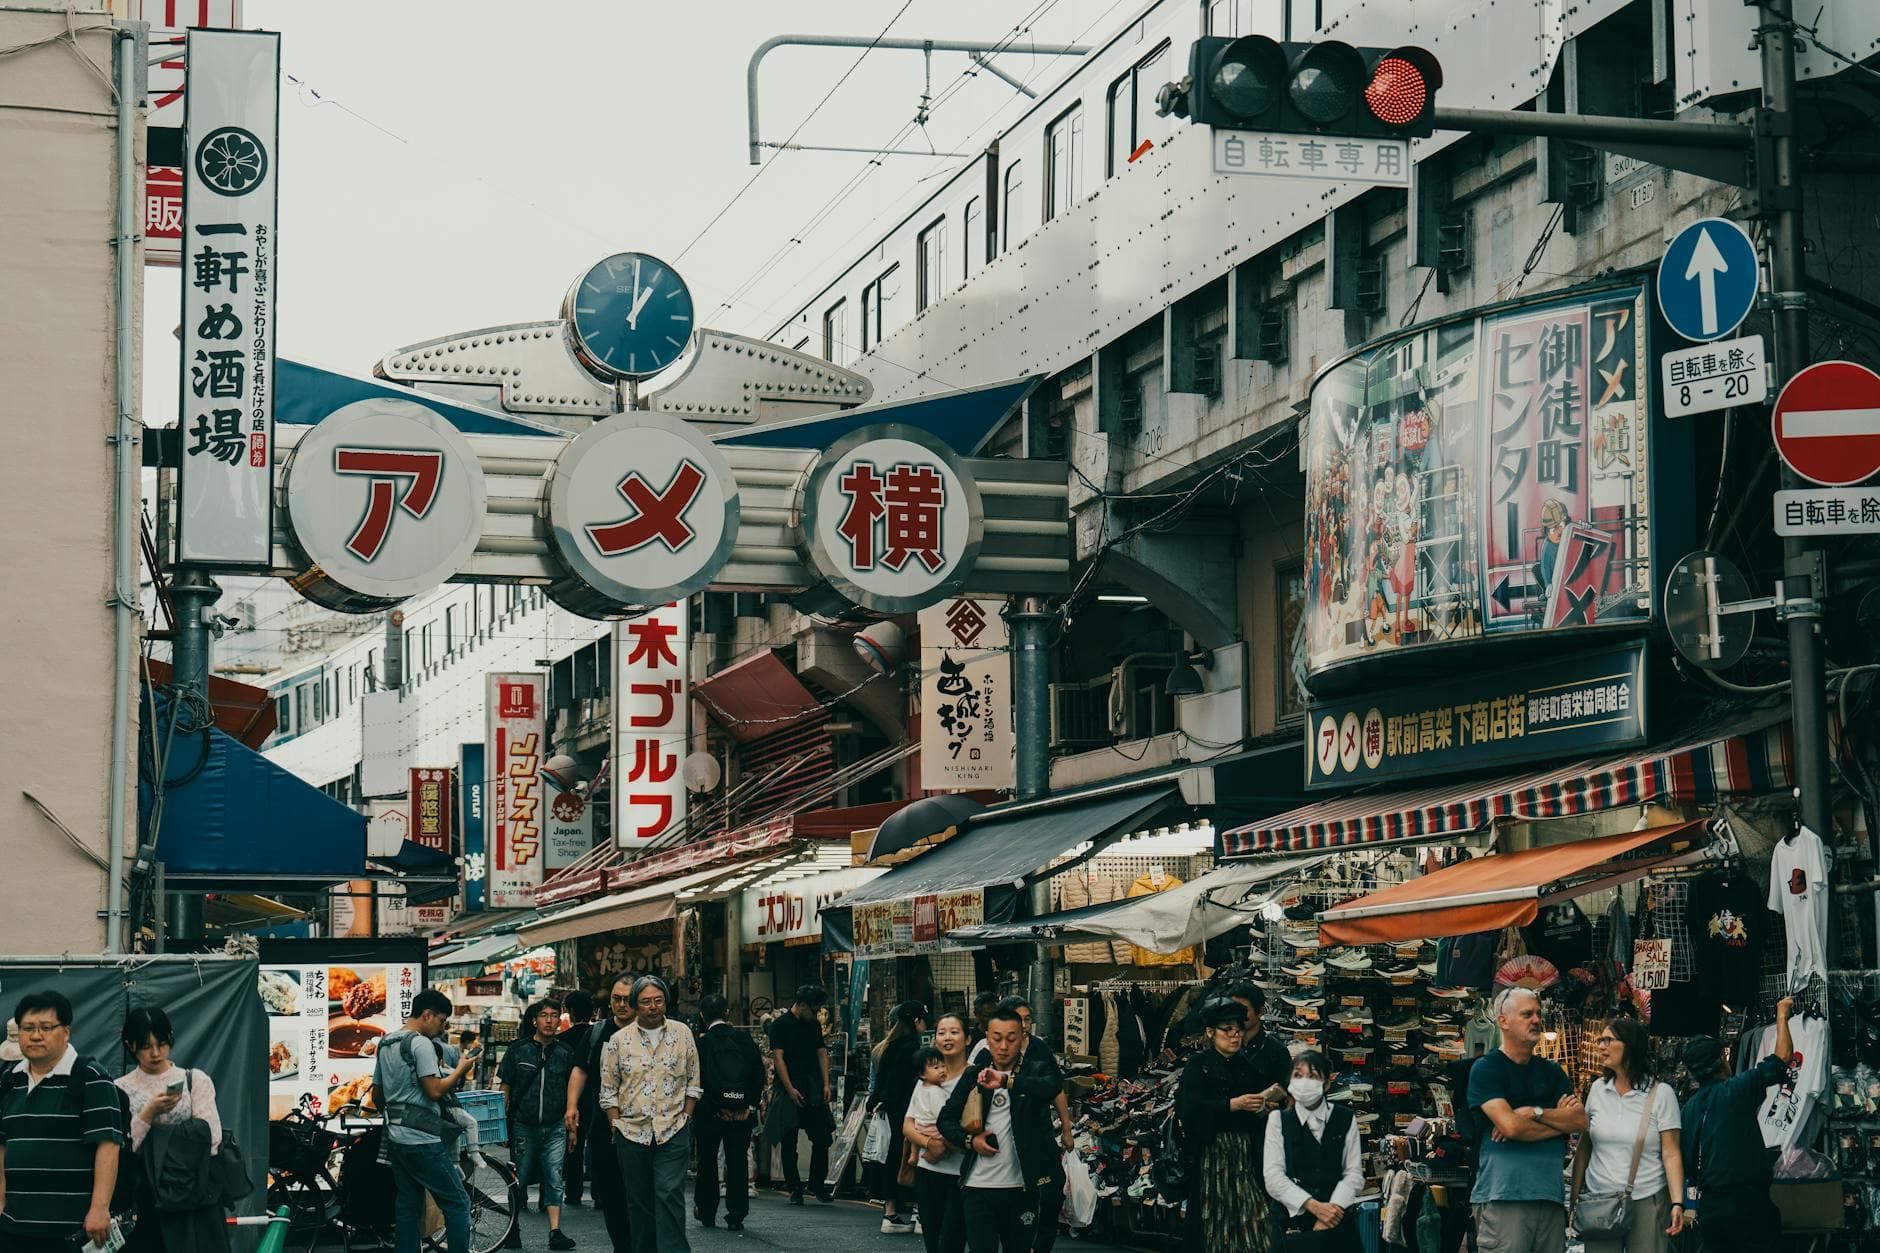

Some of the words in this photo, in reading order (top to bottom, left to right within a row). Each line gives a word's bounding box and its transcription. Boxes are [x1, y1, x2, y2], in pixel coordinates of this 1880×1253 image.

[1224, 135, 1401, 176] 自転車専用
[252, 223, 268, 431] おやじが喜ぶこだわりの酒と肴だけの店
[187, 223, 249, 467] 一軒め酒場
[1670, 348, 1755, 382] 自転車を除く
[1537, 321, 1582, 494] 御徒町
[1145, 425, 1163, 458] 206
[1491, 331, 1537, 561] センター
[504, 706, 529, 714] JJT
[628, 602, 682, 838] 木ゴルフ
[983, 674, 995, 742] ホルモン酒場
[472, 785, 480, 819] OUTLET
[552, 838, 586, 847] Tax-free
[553, 827, 584, 838] Japan.
[558, 848, 580, 858] Shop
[1634, 940, 1662, 954] BARGAIN
[1645, 951, 1668, 963] SALE
[315, 970, 325, 999] ちくわ
[723, 1091, 745, 1099] adidas
